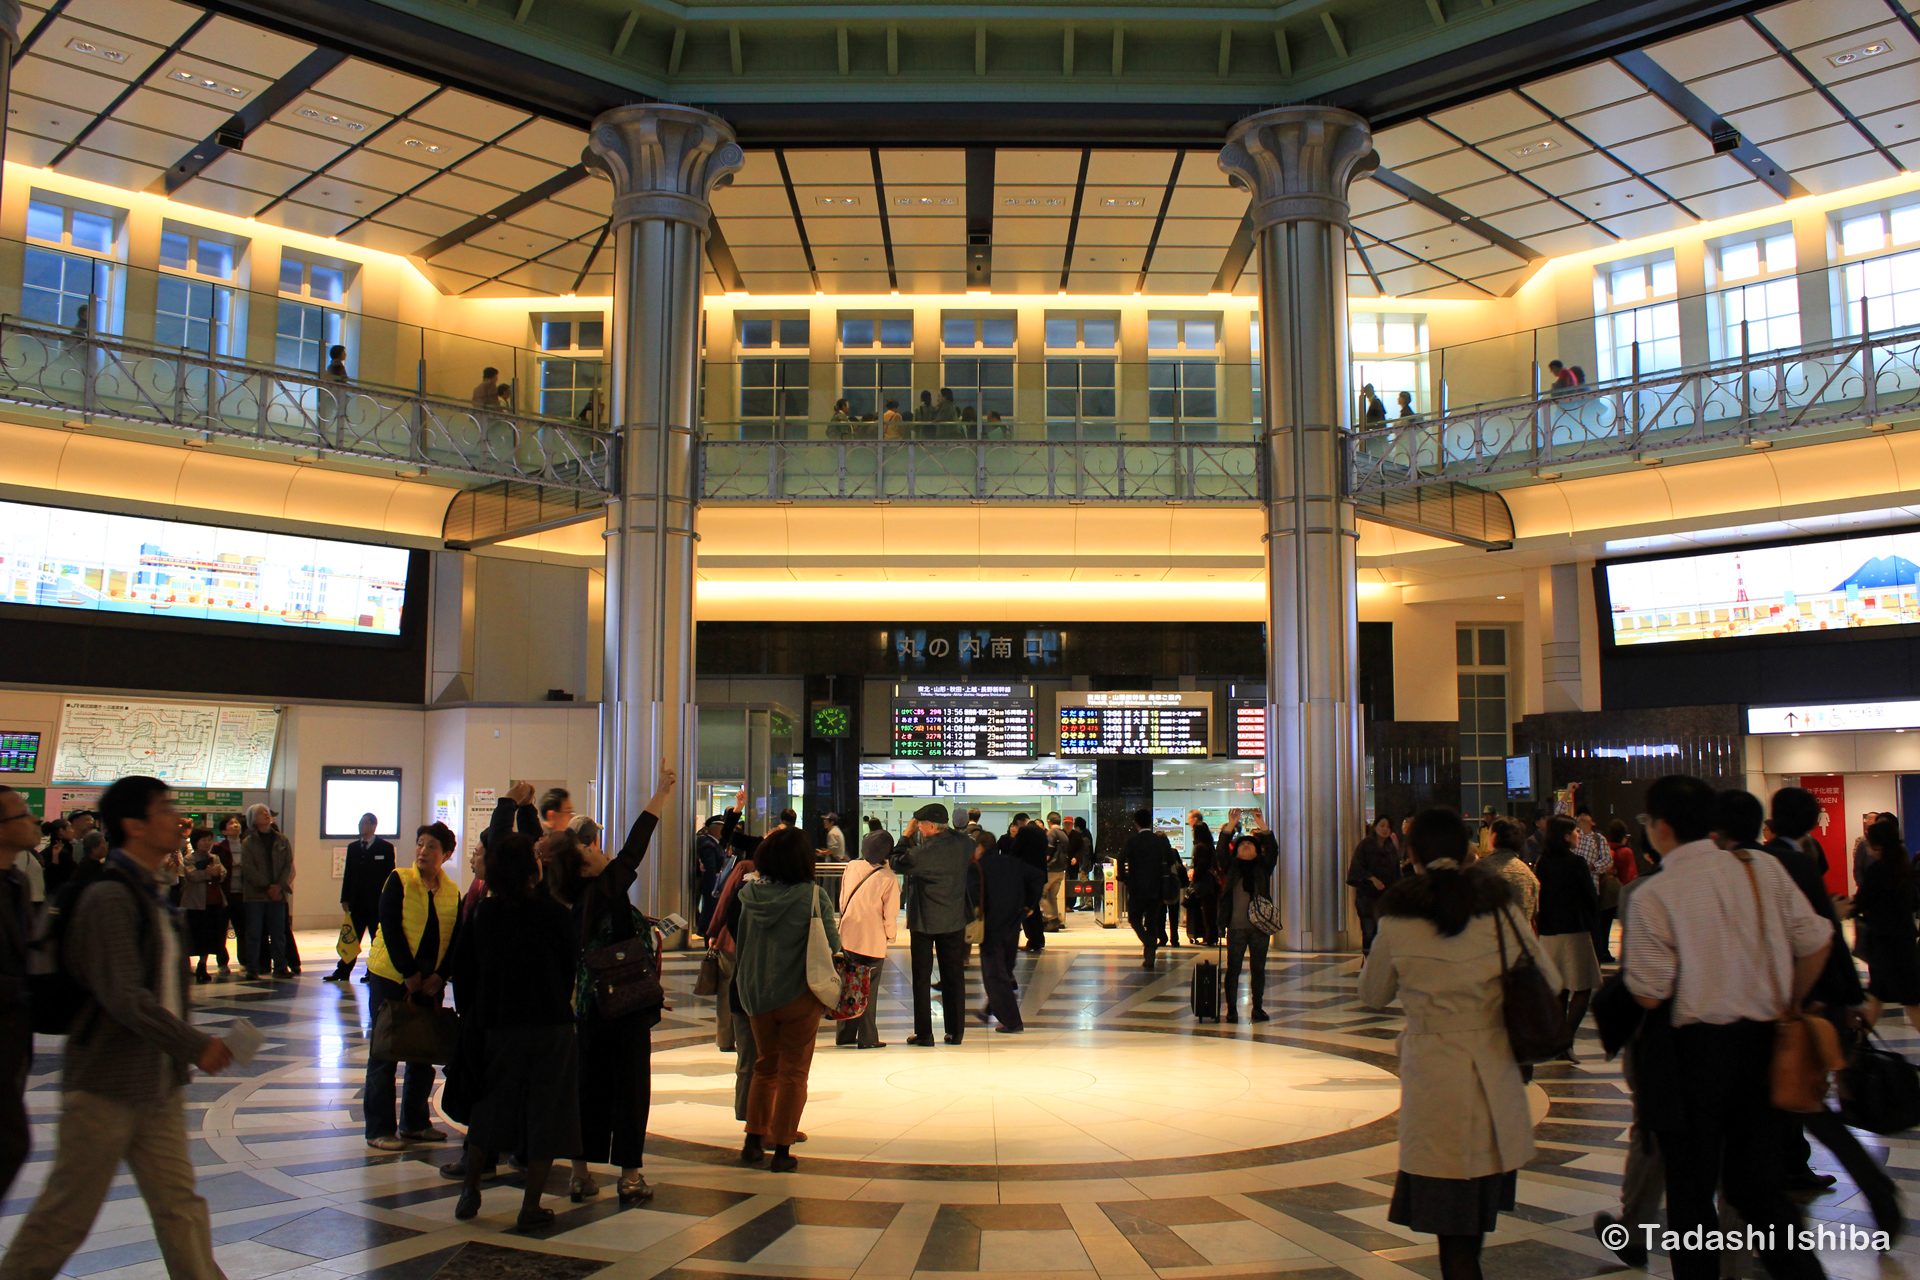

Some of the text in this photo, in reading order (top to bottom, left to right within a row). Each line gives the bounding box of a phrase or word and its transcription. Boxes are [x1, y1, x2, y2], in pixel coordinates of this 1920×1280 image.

[898, 636, 1043, 659] 丸の内南口
